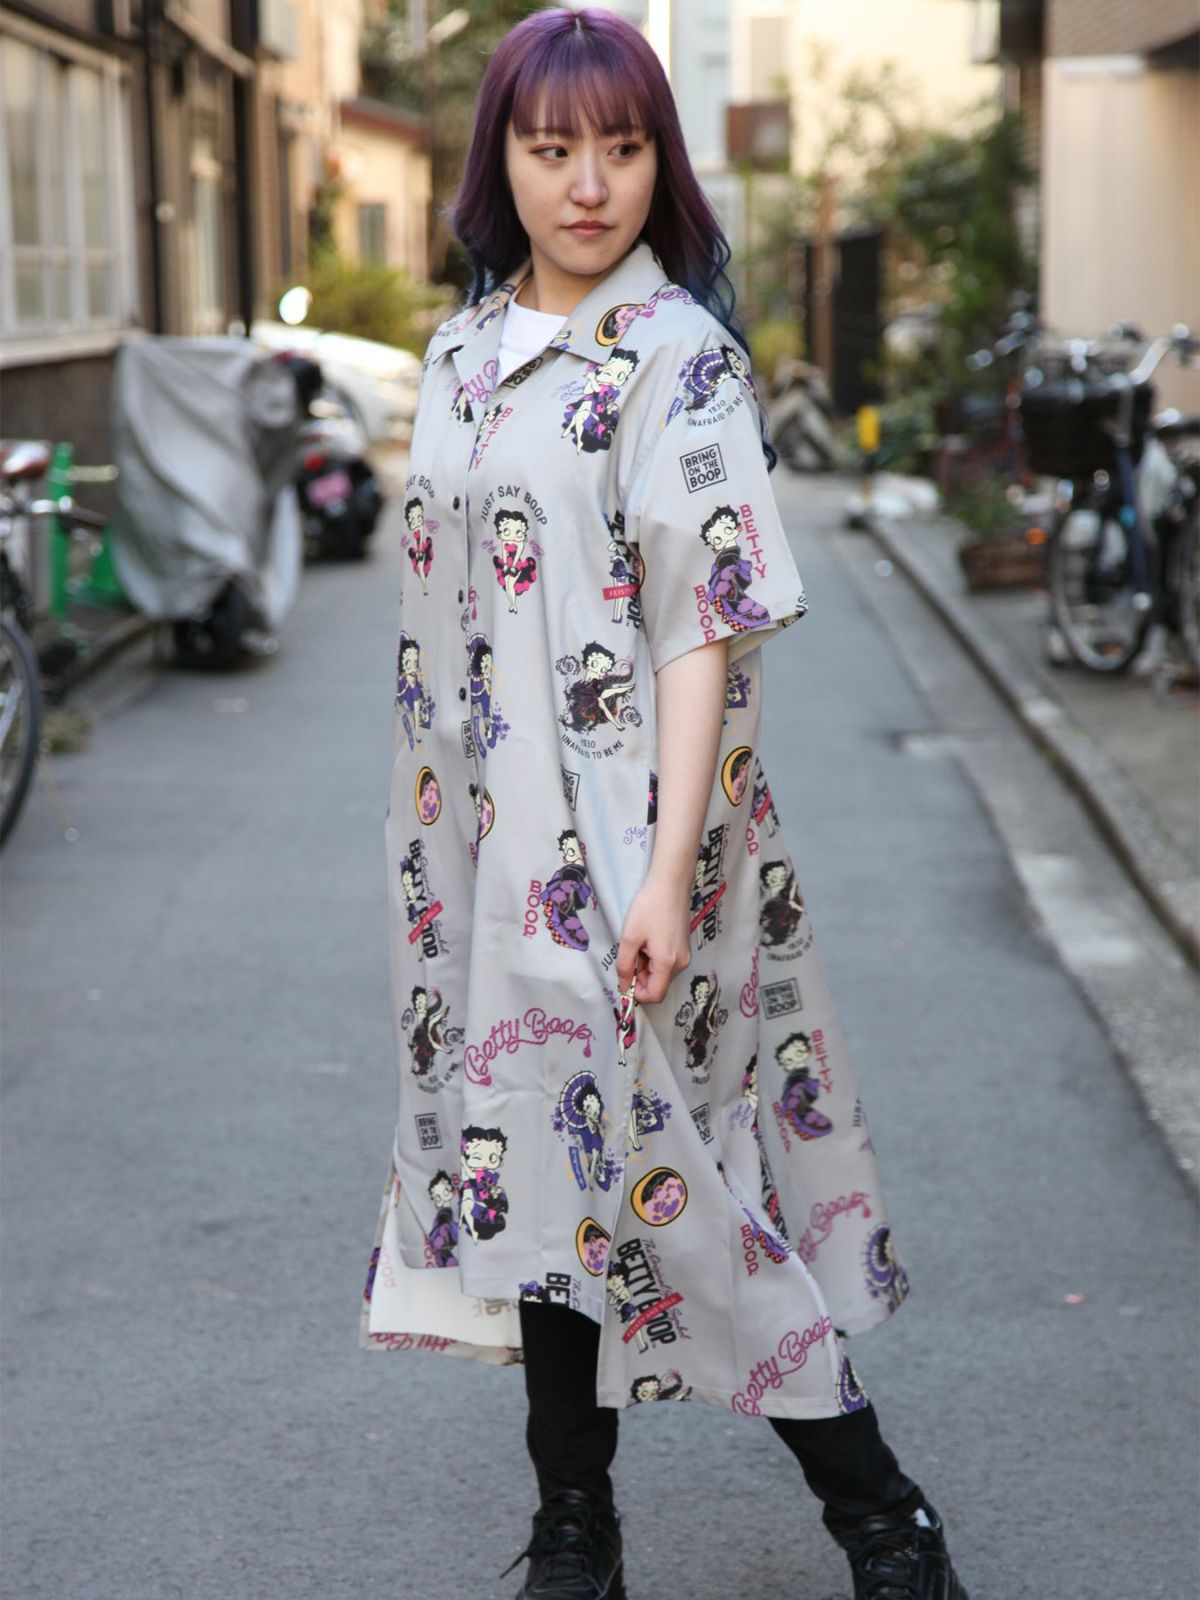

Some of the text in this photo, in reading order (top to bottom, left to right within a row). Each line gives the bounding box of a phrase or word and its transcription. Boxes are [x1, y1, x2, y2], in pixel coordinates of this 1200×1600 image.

[687, 394, 744, 427] UNAFRAID TO BE
[708, 399, 726, 414] 1930
[474, 407, 513, 469] BETTY
[685, 449, 717, 468] BRING
[688, 459, 718, 476] ON THE
[690, 467, 721, 488] BOOP
[481, 484, 548, 525] JUST SAY BOOP
[739, 504, 767, 579] BETTY
[693, 584, 716, 644] BOOP
[592, 751, 602, 760] TO
[603, 747, 614, 757] BE
[613, 740, 624, 752] ME
[522, 879, 542, 938] BOOP
[463, 1018, 521, 1087] Betty
[523, 1007, 592, 1058] Boop
[811, 1029, 833, 1094] BETTY
[616, 1238, 660, 1297] BETTY
[741, 1224, 759, 1277] BOOP
[731, 1314, 833, 1416] Betty Boop
